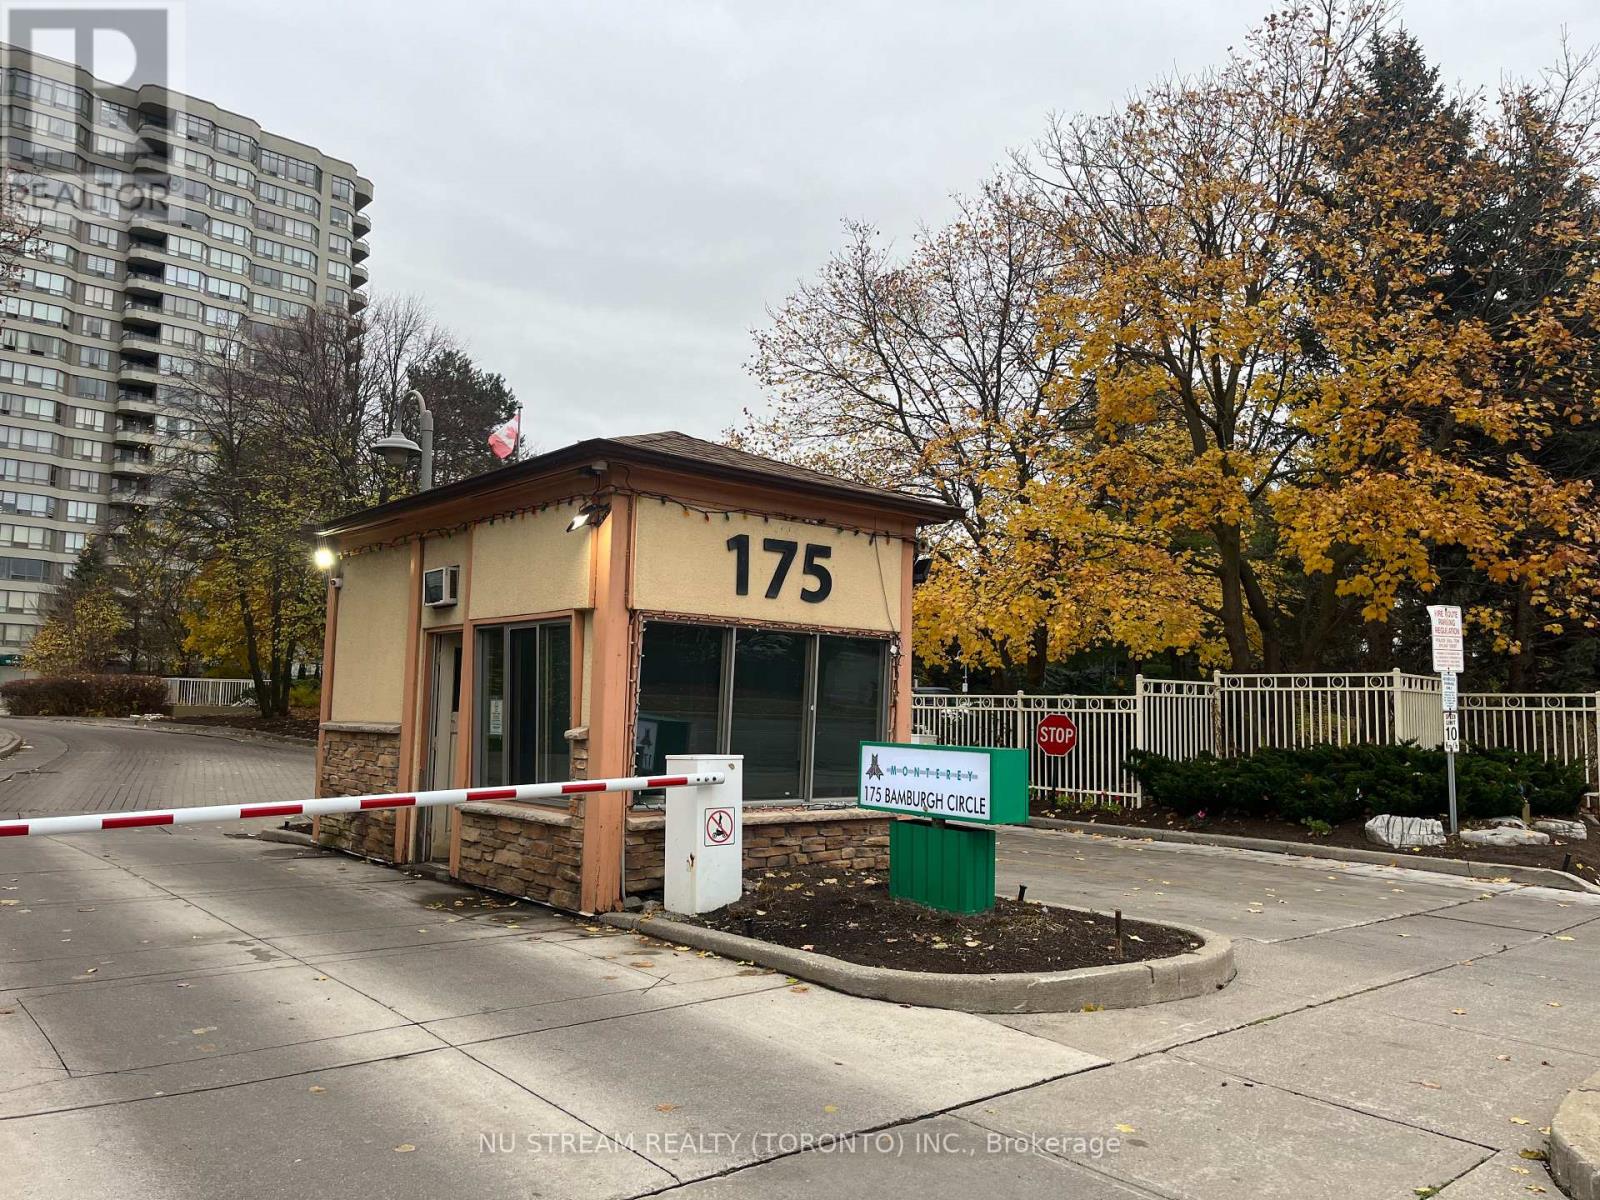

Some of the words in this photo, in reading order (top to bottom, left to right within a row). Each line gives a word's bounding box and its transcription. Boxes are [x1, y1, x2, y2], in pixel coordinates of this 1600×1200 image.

[727, 534, 832, 604] 175
[1040, 726, 1074, 743] STOP
[1446, 726, 1457, 741] 10
[890, 765, 973, 782] MONTEREY
[865, 785, 882, 803] 175
[885, 787, 944, 811] BAMBURGH
[947, 794, 986, 815] CIRCLE
